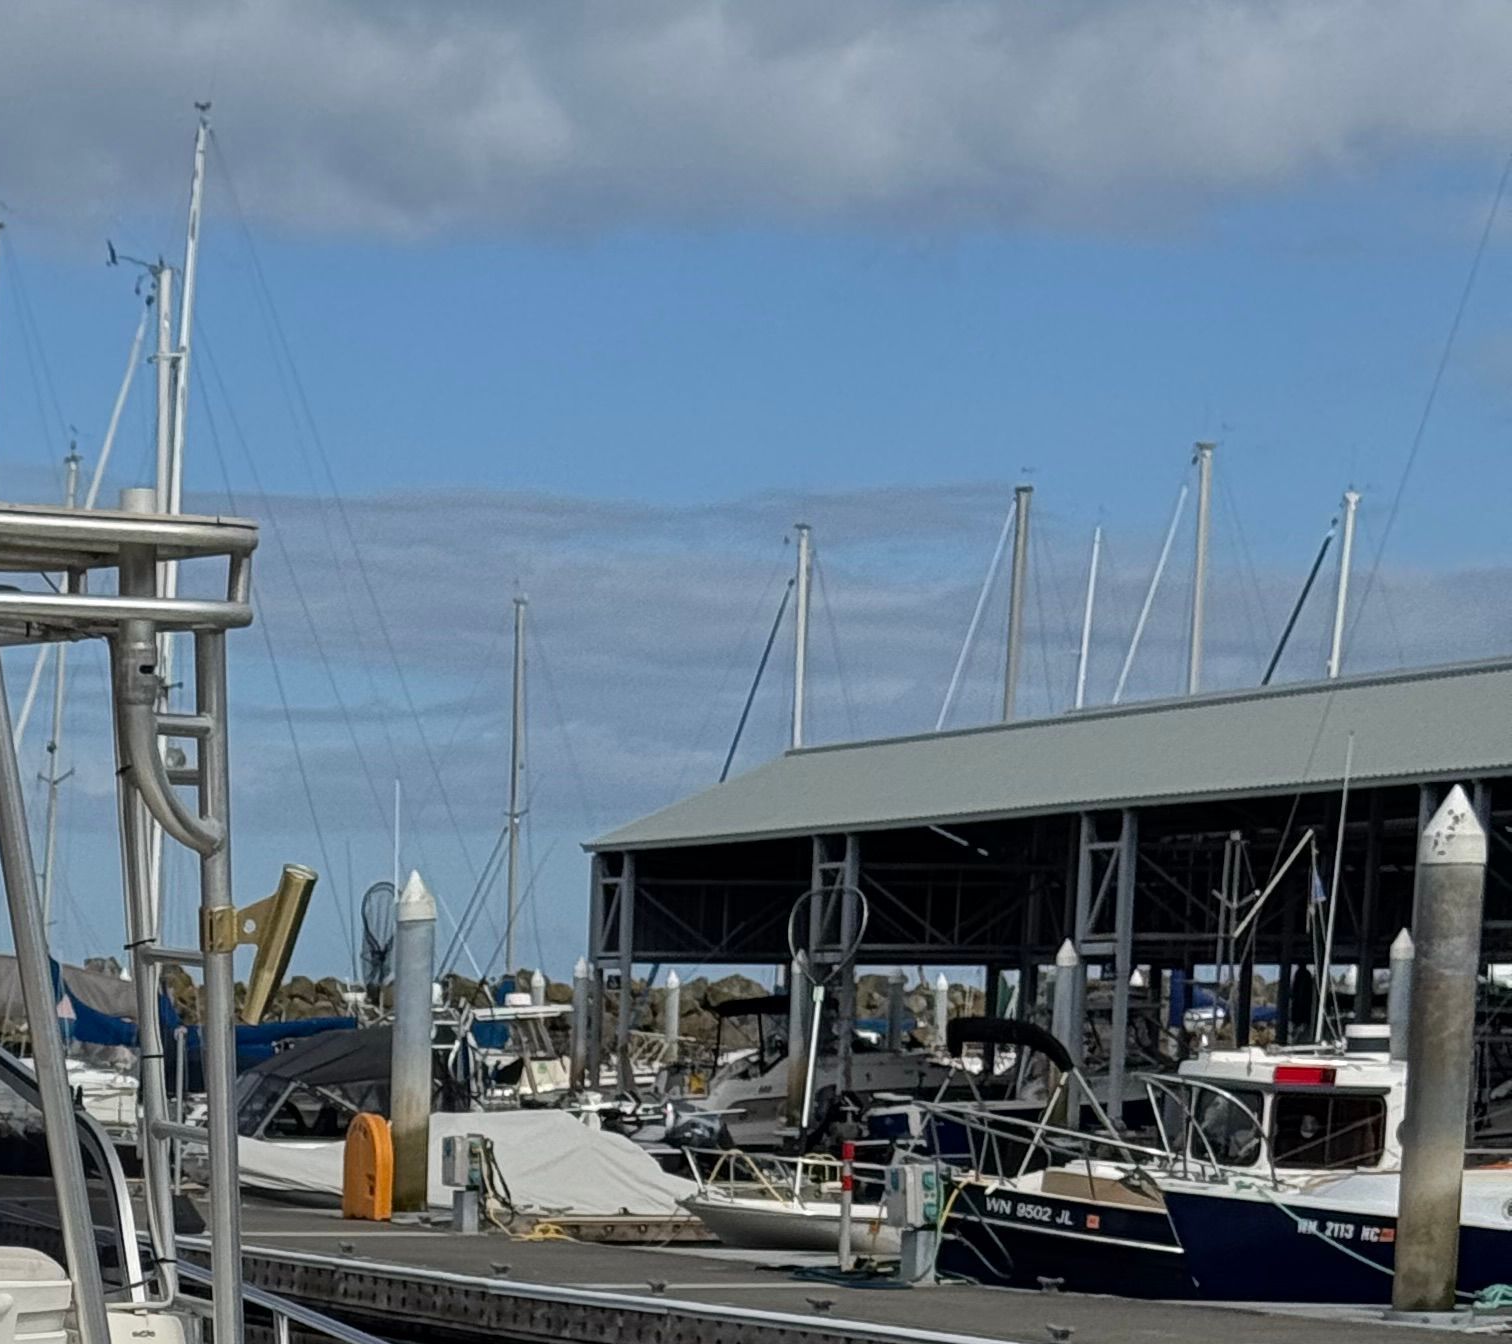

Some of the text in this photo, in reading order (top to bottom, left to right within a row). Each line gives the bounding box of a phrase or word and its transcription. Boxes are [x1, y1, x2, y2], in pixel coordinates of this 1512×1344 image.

[986, 1197, 1012, 1215] WN
[1016, 1203, 1052, 1222] 9502
[1055, 1209, 1074, 1226] JL
[1324, 1221, 1355, 1240] 2113
